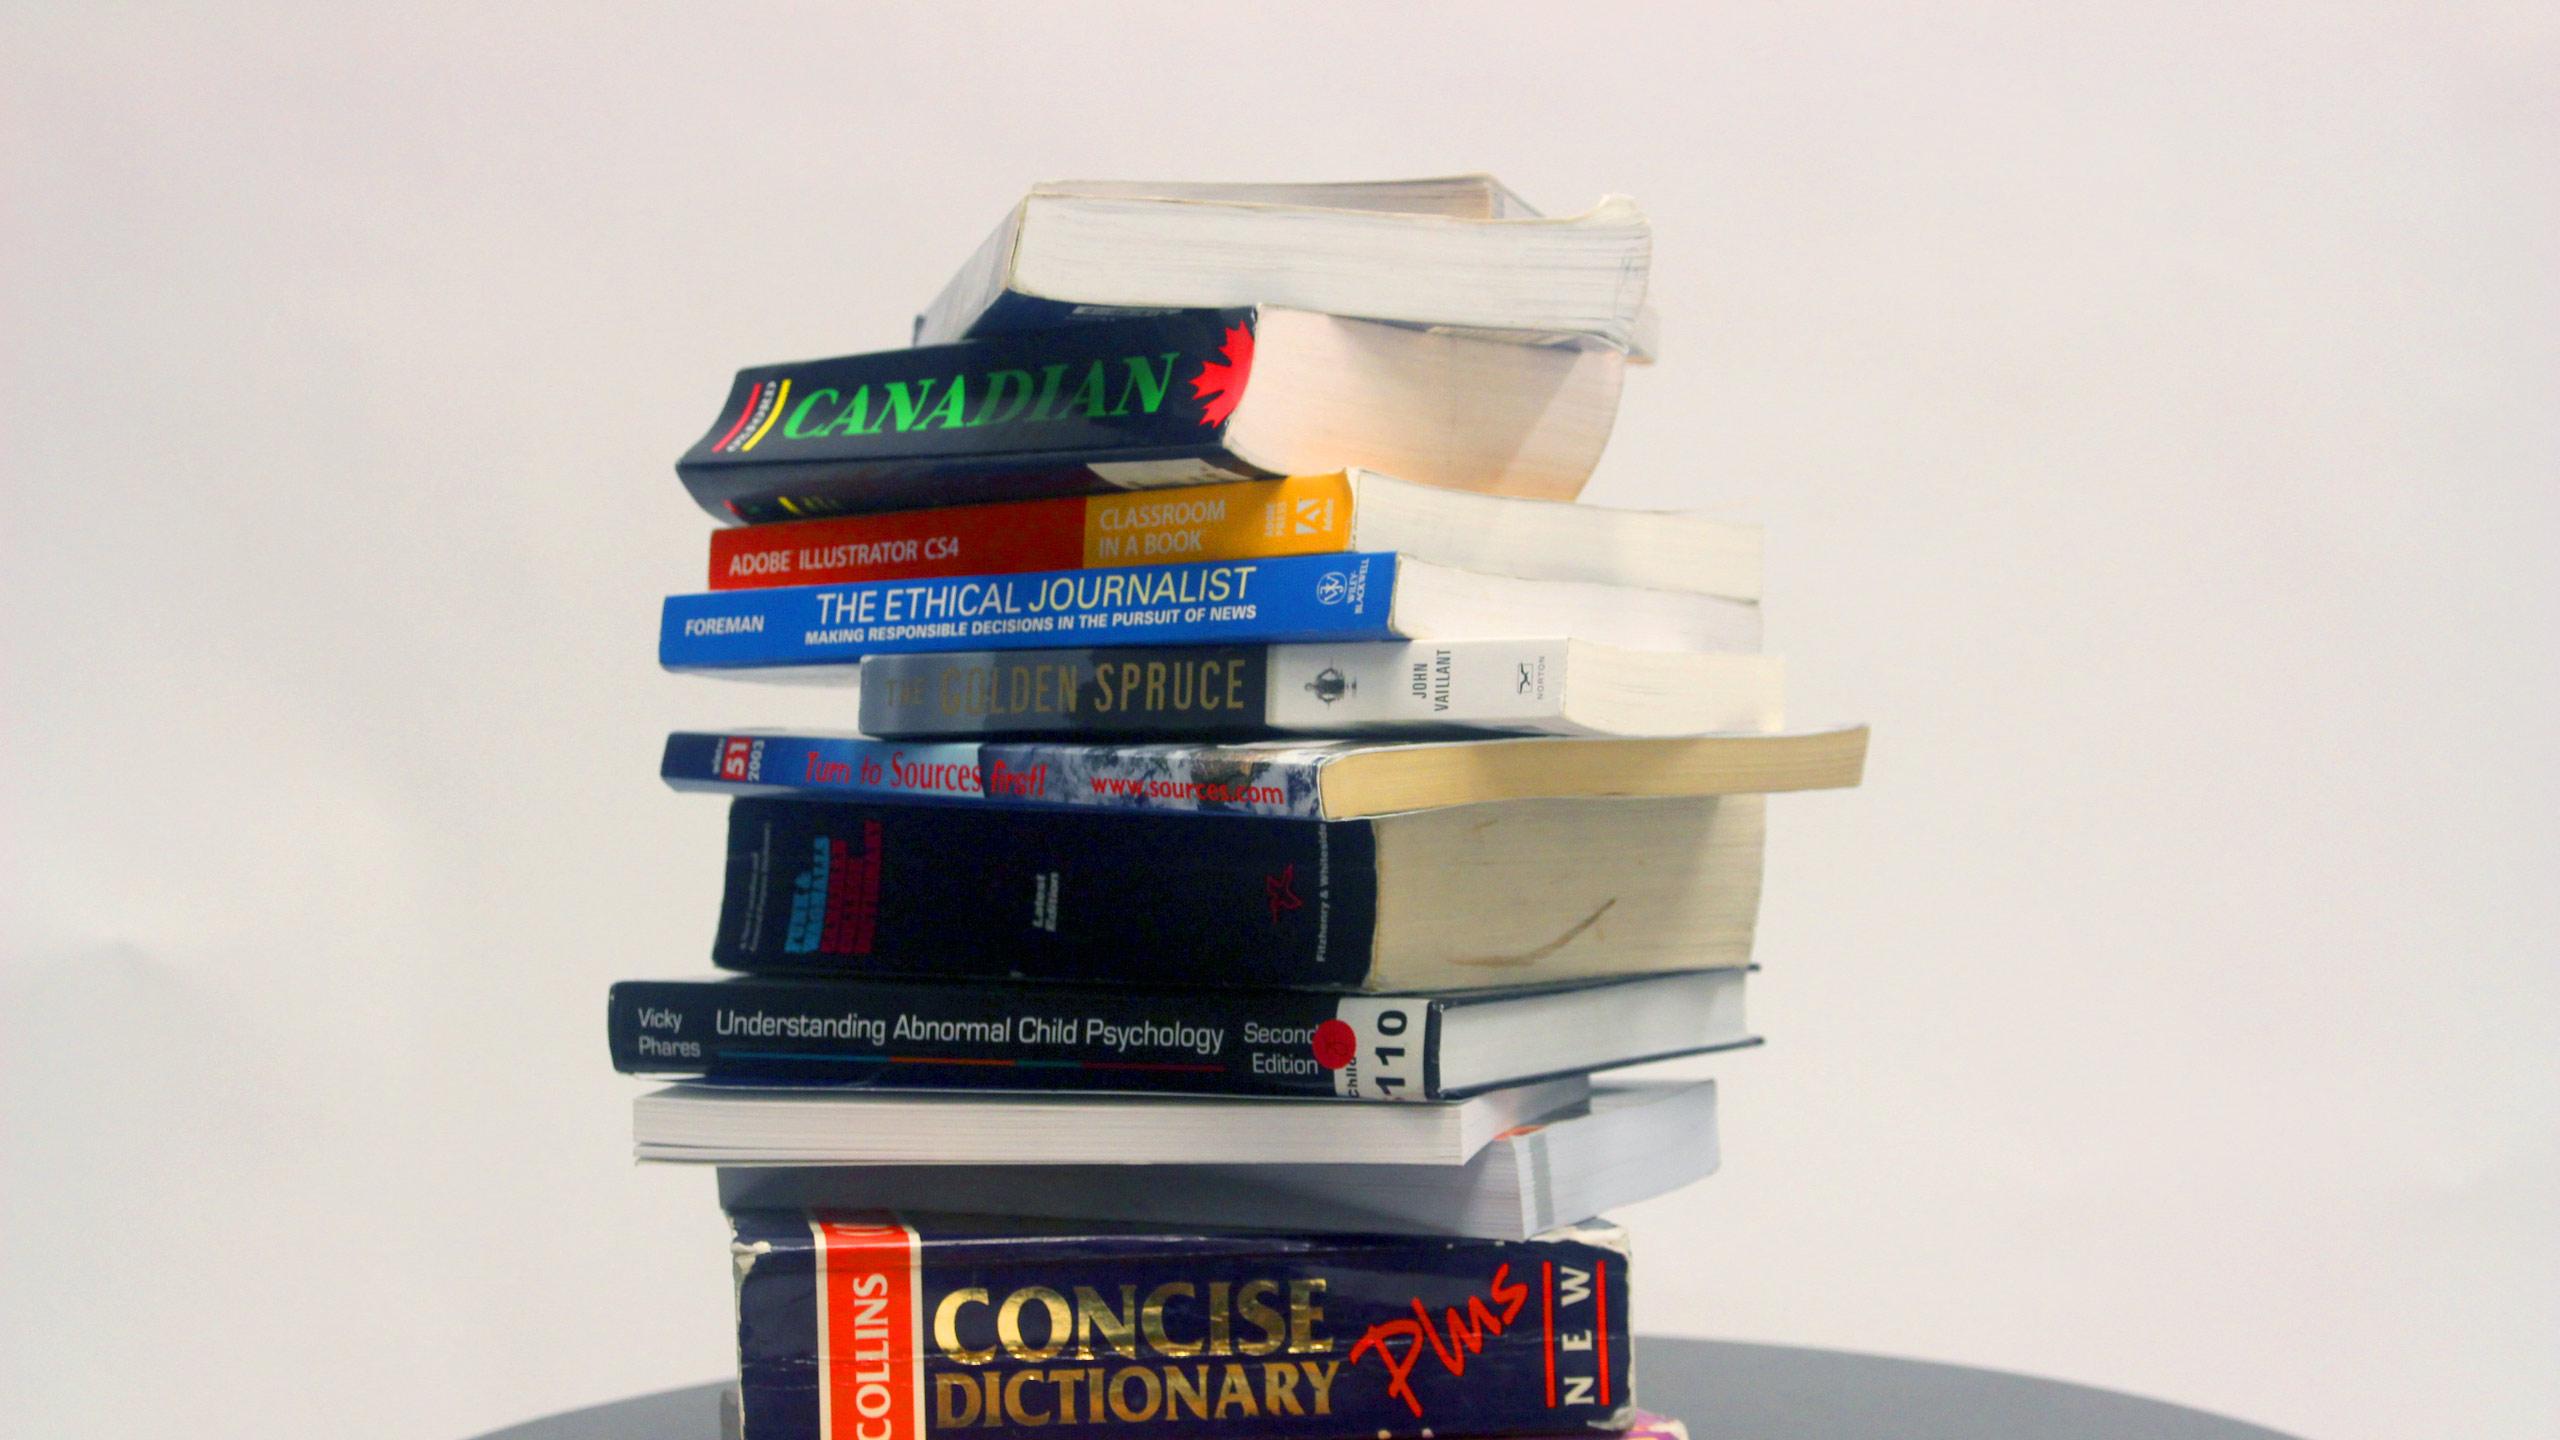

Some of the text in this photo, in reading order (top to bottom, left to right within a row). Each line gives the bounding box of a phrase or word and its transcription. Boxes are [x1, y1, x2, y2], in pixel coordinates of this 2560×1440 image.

[784, 353, 1179, 441] CANADIAN
[1100, 499, 1226, 531] CLASSROOM
[730, 537, 960, 576] ADOBE ILLUSTRATOR CS4
[1100, 530, 1203, 558] IN A BOOK
[816, 566, 1257, 624] THE ETHICAL JOURNALIST
[1354, 558, 1370, 614] BLACKWELL
[685, 615, 765, 637] FOREMAN
[805, 604, 1257, 645] MAKING RESPONSIBLE DECISIONS IN THE PURSUIT OF NEWS
[939, 662, 1078, 717] GOLDEN
[1093, 660, 1245, 711] SPRUCE
[1412, 663, 1428, 699] JOHN
[1434, 649, 1451, 712] VAILLANT
[1536, 655, 1546, 700] NORTON
[726, 741, 747, 777] 51
[748, 740, 765, 781] 2003
[805, 751, 1047, 796] Turn to Sources first!
[1090, 777, 1285, 805] www.sources.com
[638, 1008, 683, 1034] Vicky
[716, 1009, 1225, 1055] Understanding Abnormal Child Psychology
[638, 1037, 701, 1058] Phares
[1252, 1053, 1319, 1075] Edition
[1374, 1009, 1408, 1096] 110
[933, 1278, 1334, 1365] CONCISE
[1349, 1262, 1529, 1418] Plus
[1560, 1266, 1595, 1407] NEW
[853, 1273, 893, 1440] COLLINS
[935, 1361, 1340, 1429] DICTIONARY
